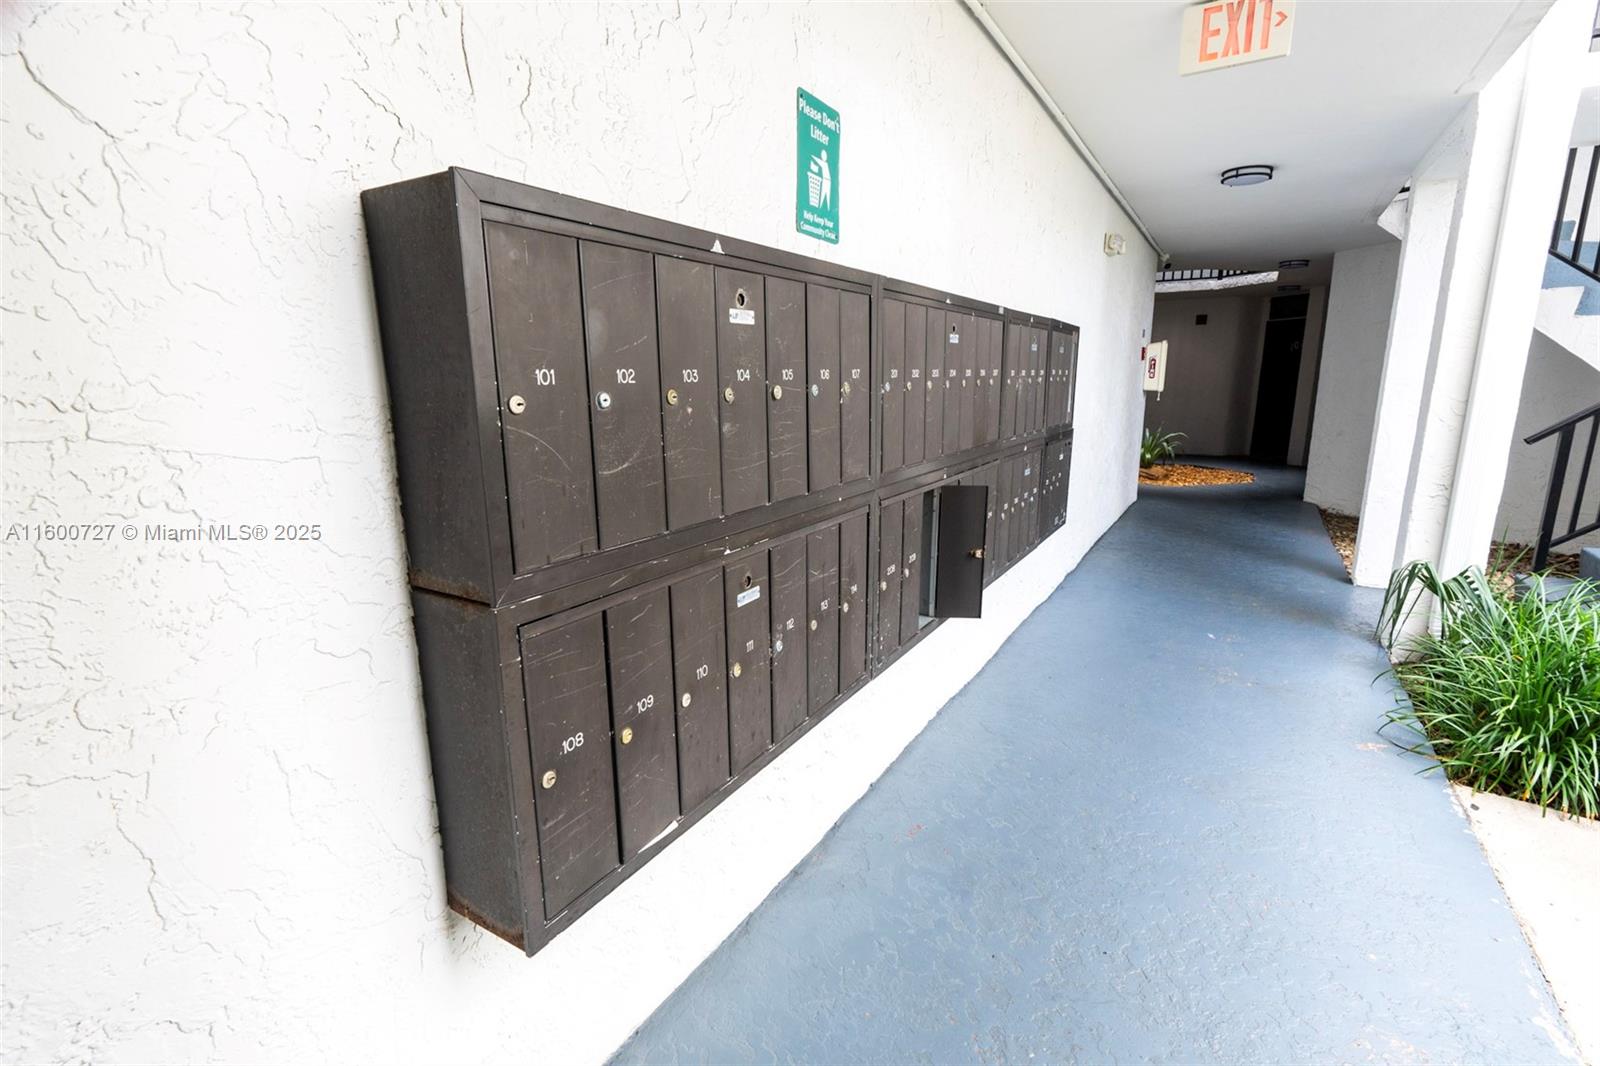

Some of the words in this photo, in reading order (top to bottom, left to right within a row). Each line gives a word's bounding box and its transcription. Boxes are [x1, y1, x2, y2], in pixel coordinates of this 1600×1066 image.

[1199, 0, 1273, 63] EXIT
[799, 97, 821, 123] Please
[822, 111, 840, 134] Don't
[810, 123, 829, 146] Litter
[535, 369, 556, 385] 101
[616, 368, 636, 384] 102
[682, 369, 699, 383] 103
[736, 369, 750, 382] 104
[782, 369, 794, 380] 105
[820, 369, 830, 380] 106
[851, 368, 861, 379] 107
[786, 617, 795, 631] 112
[746, 639, 754, 653] 111
[696, 664, 709, 680] 110
[636, 694, 654, 714] 109
[562, 732, 584, 755] 108
